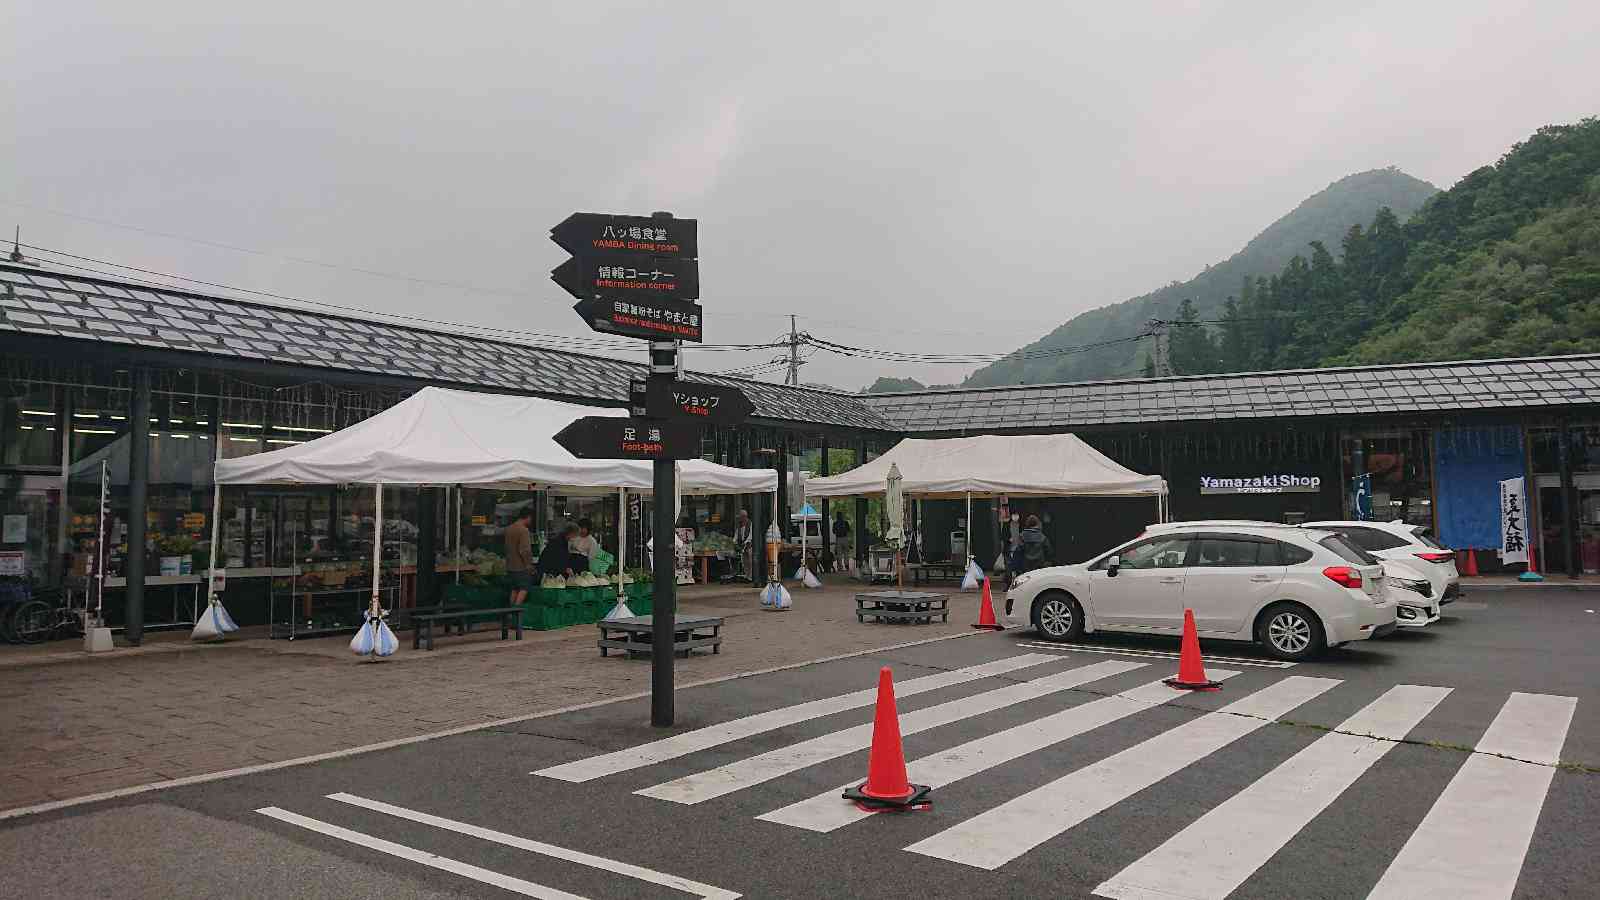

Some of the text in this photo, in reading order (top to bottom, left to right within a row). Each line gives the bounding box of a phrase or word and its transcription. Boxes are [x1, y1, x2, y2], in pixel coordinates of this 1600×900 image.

[602, 225, 667, 241] 八ッ場食堂
[592, 240, 680, 252] YAMBA Dining room
[598, 266, 675, 281] 情報コーナー
[596, 279, 675, 290] Information corner
[1200, 474, 1321, 488] Yamazaki Shop
